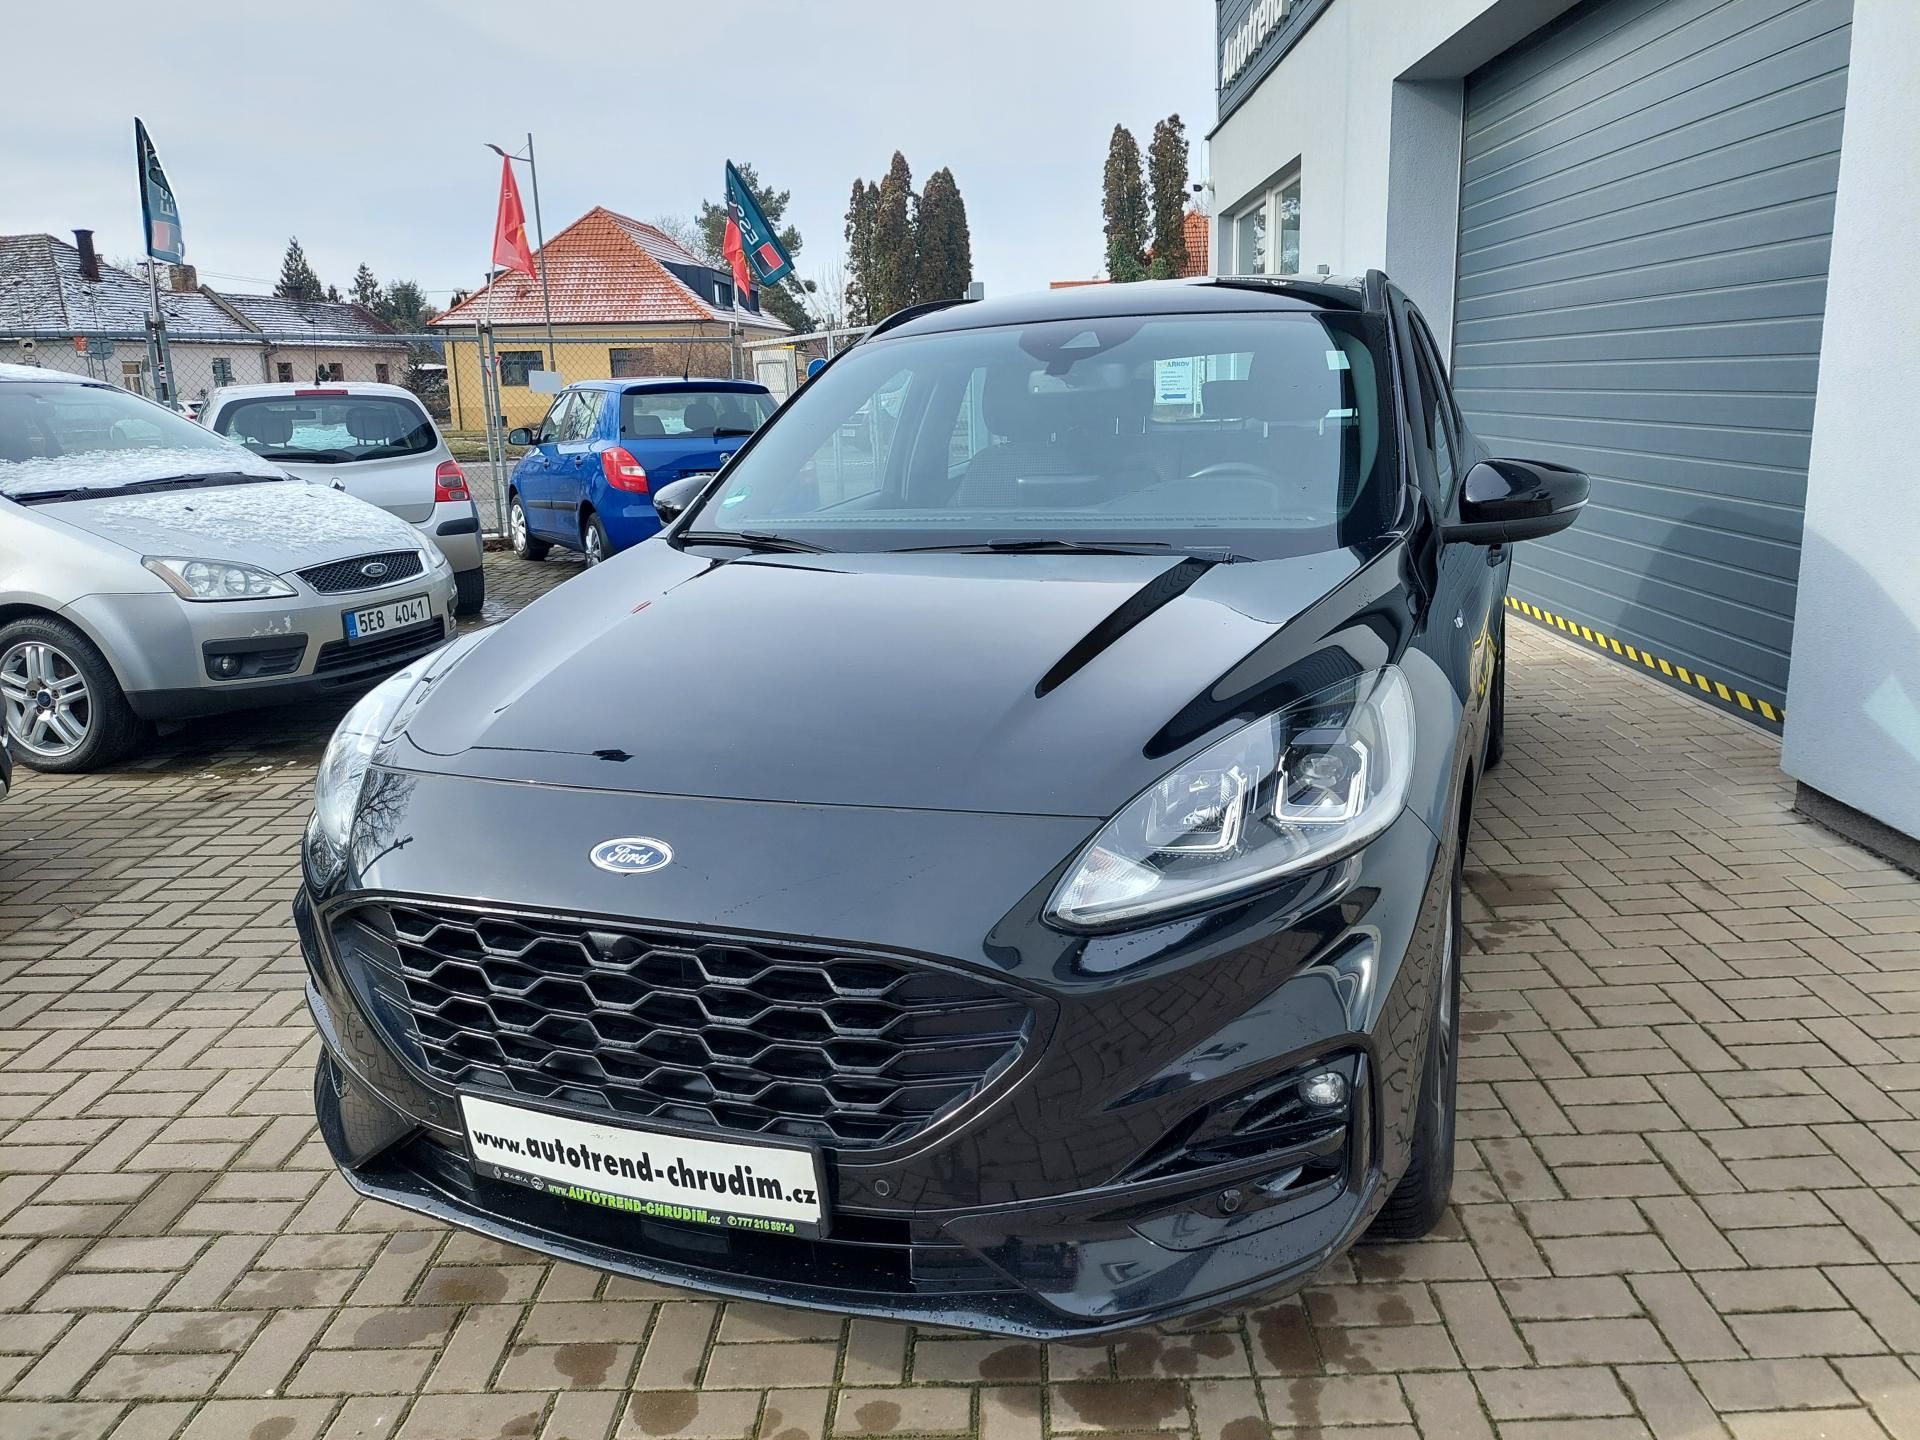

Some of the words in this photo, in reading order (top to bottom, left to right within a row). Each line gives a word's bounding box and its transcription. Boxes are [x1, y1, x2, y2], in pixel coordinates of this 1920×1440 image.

[358, 610, 385, 633] 5E8
[395, 600, 425, 624] 4041
[606, 844, 655, 865] Ford
[472, 1129, 817, 1204] www.autotrend-chrudim.cz
[548, 1184, 721, 1225] www.AUTOTREND-CHRUDIM.cz
